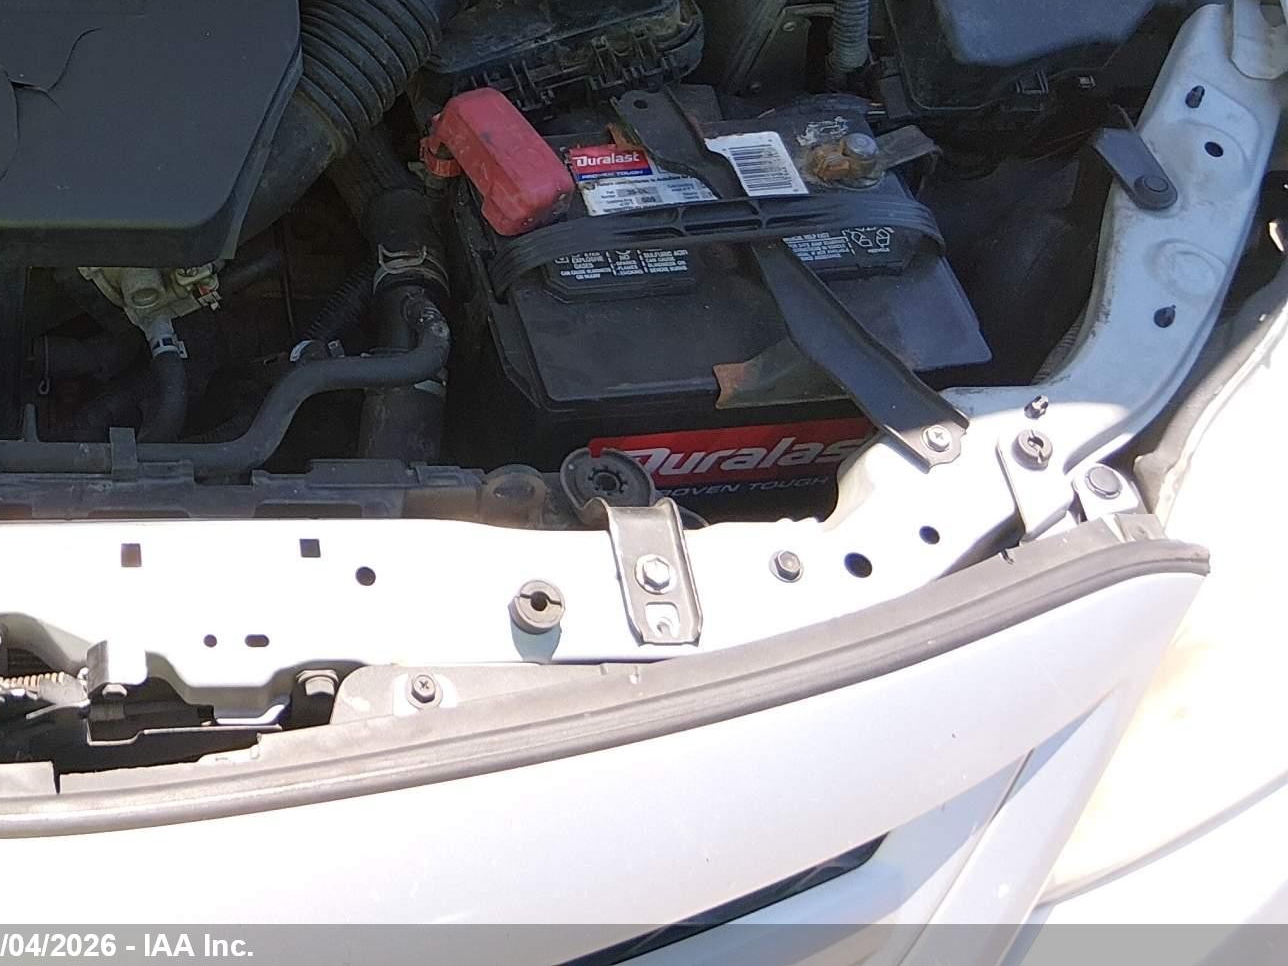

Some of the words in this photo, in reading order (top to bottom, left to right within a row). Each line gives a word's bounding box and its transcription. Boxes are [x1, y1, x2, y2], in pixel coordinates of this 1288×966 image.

[572, 152, 640, 167] Duralast
[623, 437, 865, 476] Duralas
[748, 476, 830, 491] TOUGH
